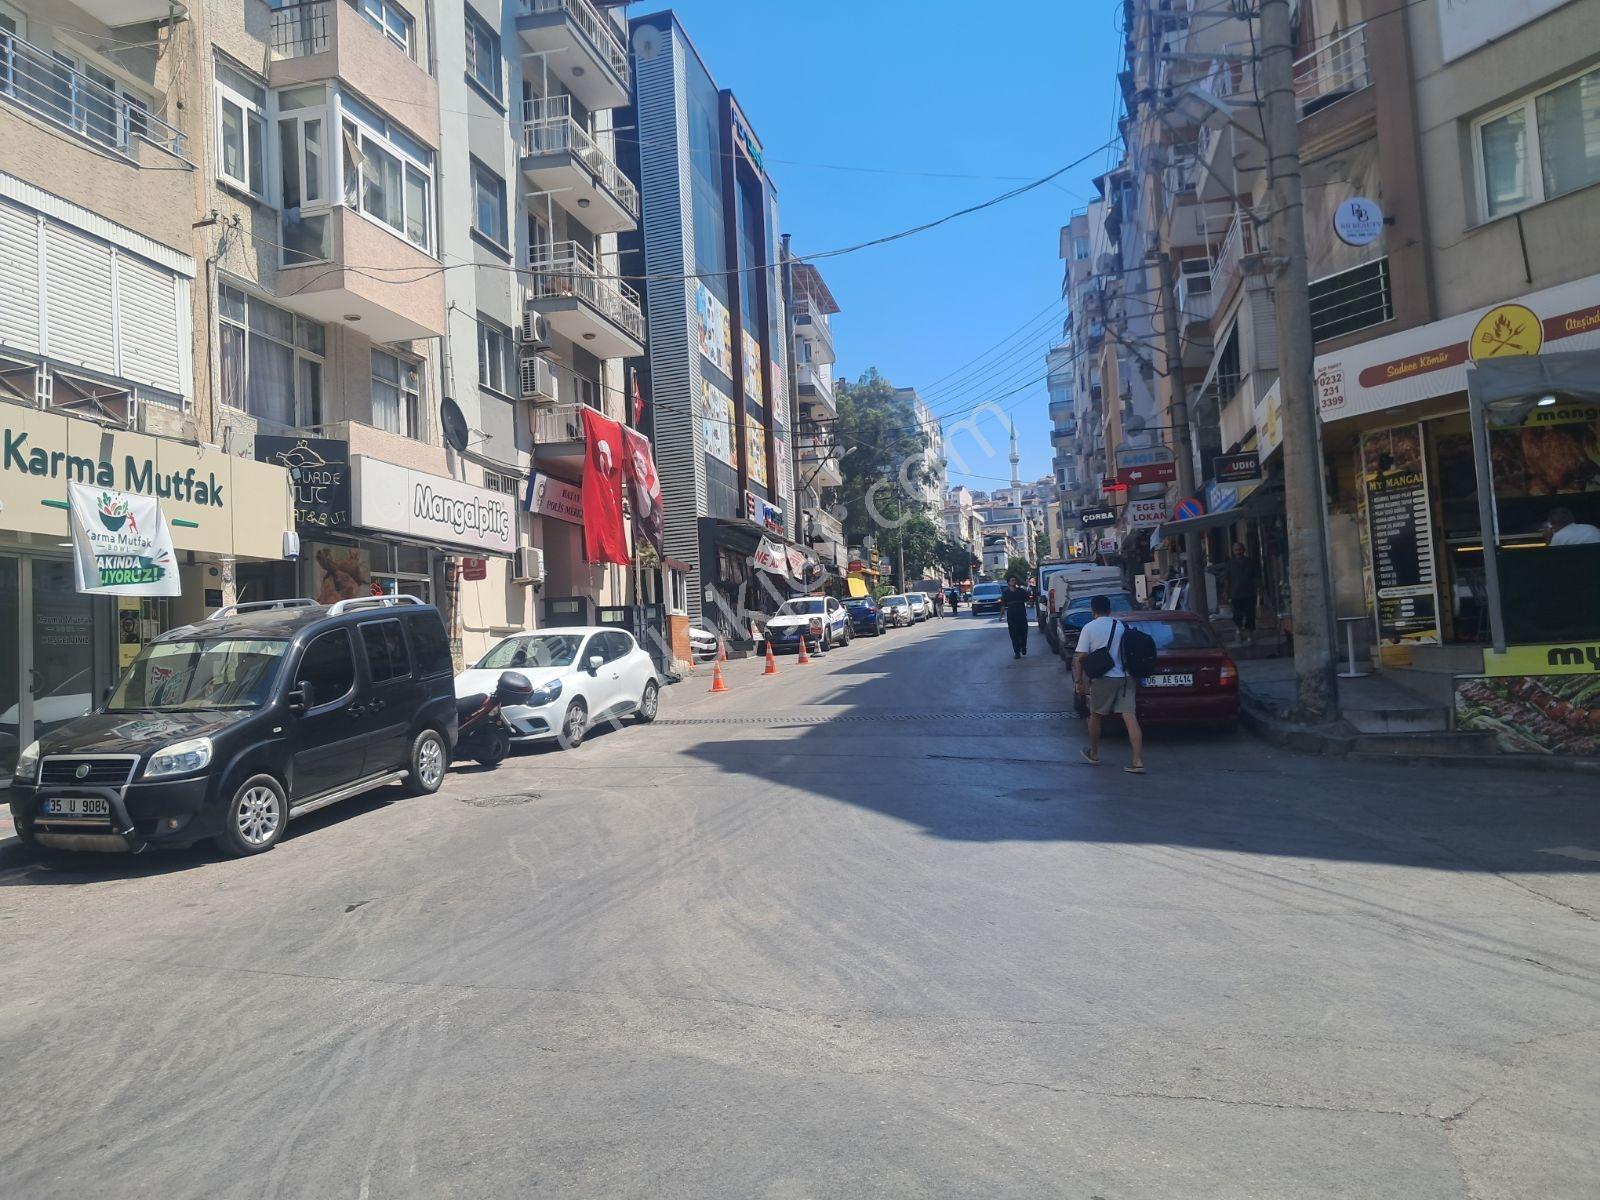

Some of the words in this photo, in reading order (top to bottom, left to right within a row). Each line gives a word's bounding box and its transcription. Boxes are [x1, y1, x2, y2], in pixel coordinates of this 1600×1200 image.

[1387, 362, 1417, 377] Sadece
[1420, 351, 1449, 368] Kömür
[1319, 374, 1342, 387] 0232
[1323, 386, 1339, 397] 231
[1321, 396, 1344, 408] 3399
[3, 428, 115, 488] Karma
[124, 455, 224, 508] Mutfak
[298, 471, 341, 485] URDE
[1369, 481, 1382, 491] MY
[1385, 472, 1424, 488] MANGAL
[413, 483, 510, 543] Mangalpiliç
[546, 499, 564, 514] POLİS
[1136, 503, 1155, 512] EGE
[1082, 511, 1114, 523] ÇORBA
[1133, 512, 1168, 522] LOKAN
[117, 533, 152, 548] Mutfak
[1162, 675, 1172, 684] AE
[50, 799, 62, 812] 35
[69, 799, 76, 812] U
[82, 800, 107, 813] 9084
